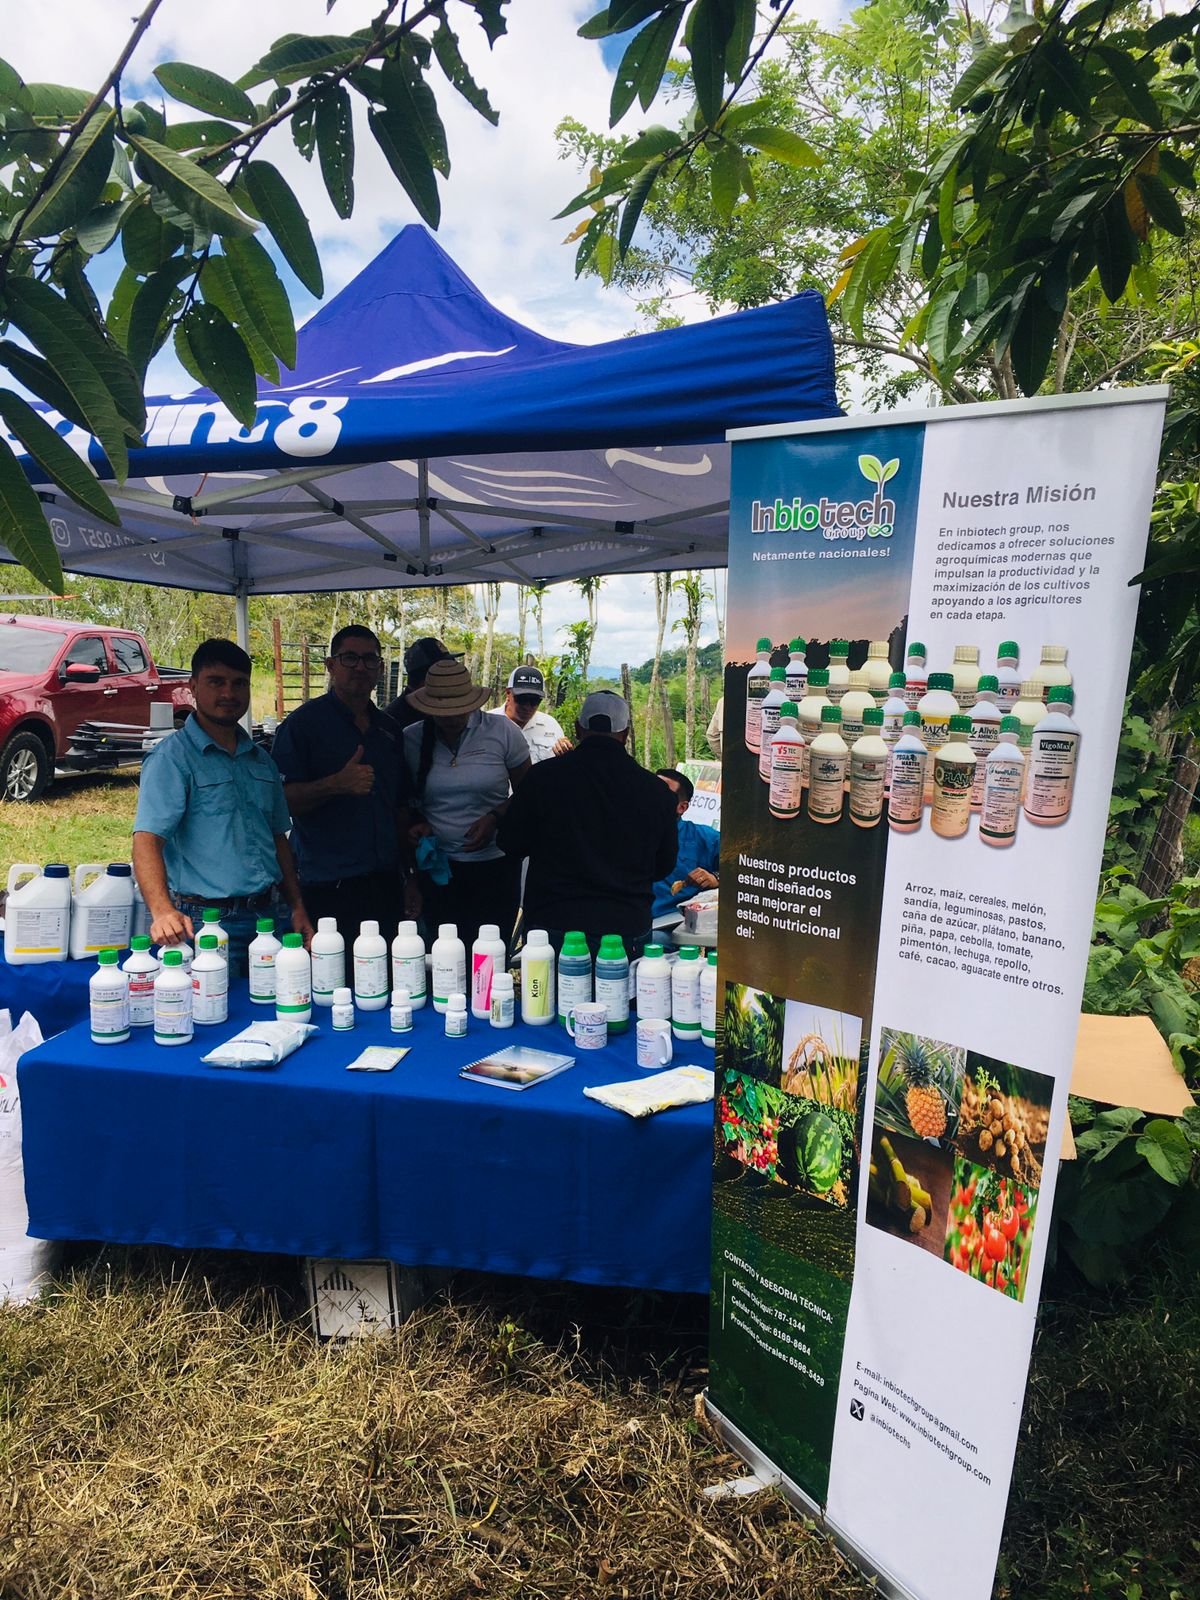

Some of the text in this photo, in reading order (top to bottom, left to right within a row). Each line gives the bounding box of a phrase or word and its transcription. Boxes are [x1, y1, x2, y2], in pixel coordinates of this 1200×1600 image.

[942, 483, 1096, 508] Nuestra Misión
[752, 492, 895, 533] Inbiotech
[823, 527, 867, 540] Group
[939, 523, 1070, 537] En inbiotech group, nos
[752, 547, 891, 561] Netamente nacionales!
[937, 541, 997, 551] dedicamos
[1008, 538, 1046, 548] ofrecer
[1049, 536, 1115, 547] soluciones
[935, 552, 1092, 566] agroquímicas modernas que
[934, 565, 1100, 580] impulsan la productividad y la
[933, 580, 1090, 592] maximización de los cultivos
[931, 596, 985, 608] apoyando
[996, 596, 1012, 605] los
[1014, 595, 1082, 607] agricultores
[930, 610, 1006, 622] en cada etapa.
[1041, 741, 1071, 750] VigoMax
[738, 853, 857, 885] Nuestros productos
[738, 874, 832, 900] estan diseñados
[905, 882, 936, 896] Arroz,
[969, 894, 1009, 909] cereales,
[1011, 901, 1046, 916] melón,
[737, 891, 821, 917] para mejorar el
[944, 902, 1006, 923] leguminosas,
[1008, 915, 1046, 931] pastos,
[736, 908, 841, 940] estado nutricional
[736, 925, 755, 939] del:
[902, 910, 1065, 950] caña de azúcar, plátano, banano,
[901, 923, 1033, 959] piña, papa, cebolla, tomate,
[900, 936, 1031, 973] pimentón, lechuga, repollo,
[899, 949, 1064, 995] café, cacao, aguacate entre otros.
[531, 978, 539, 998] Kion
[724, 1250, 756, 1278] CONTACTO
[759, 1277, 799, 1304] ASESORIA
[799, 1295, 834, 1325] TECNICA:
[731, 1278, 751, 1297] Oficina
[774, 1308, 806, 1333] 787-1344
[731, 1296, 750, 1315] Celular
[730, 1312, 756, 1340] Provincias
[755, 1334, 788, 1363] Centrales:
[856, 1361, 882, 1383] E-mail:
[853, 1379, 992, 1486] Pagina Web: www.inbiotechgroup.com
